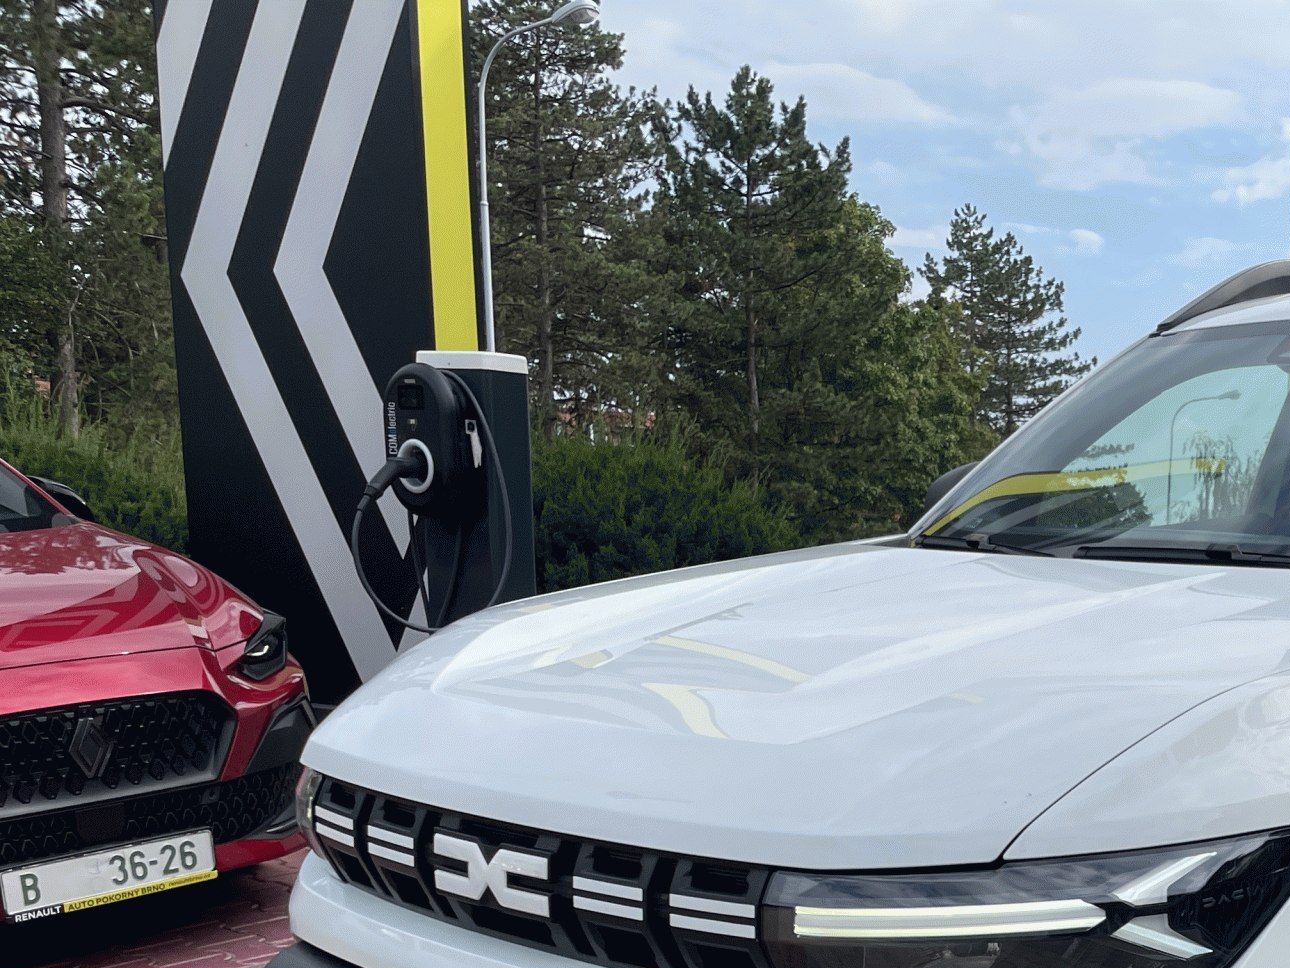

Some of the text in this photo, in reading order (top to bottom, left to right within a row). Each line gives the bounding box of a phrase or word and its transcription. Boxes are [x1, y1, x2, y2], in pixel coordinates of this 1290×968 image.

[20, 841, 198, 906] B 36-26
[15, 906, 62, 923] RENAULT
[68, 899, 95, 912] AUTO
[141, 883, 166, 895] BRNO
